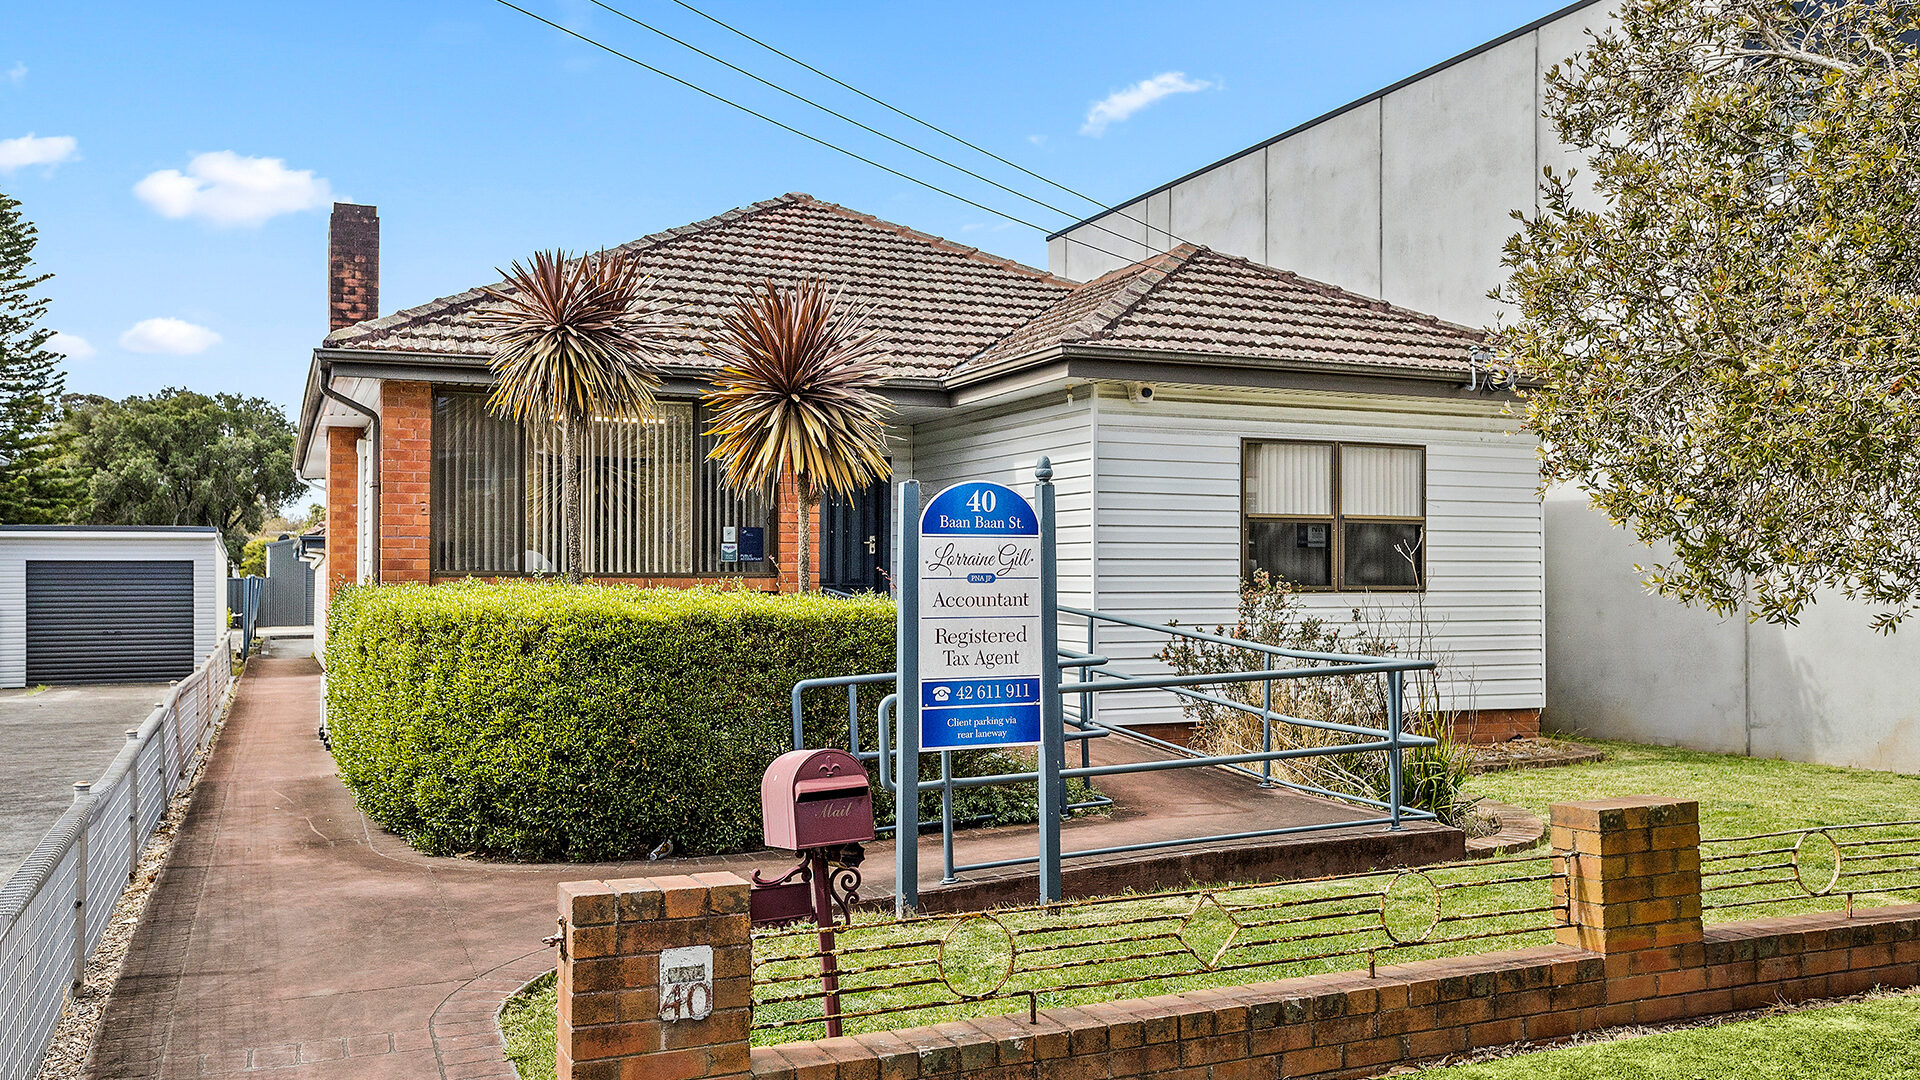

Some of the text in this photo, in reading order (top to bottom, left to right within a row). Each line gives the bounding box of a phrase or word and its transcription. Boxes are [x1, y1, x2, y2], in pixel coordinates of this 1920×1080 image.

[966, 489, 997, 513] 40
[939, 514, 1025, 529] Baan Baan St.
[928, 542, 1032, 577] Lorraine Gill
[971, 574, 993, 583] PNA JP
[932, 591, 1030, 608] Accountant
[934, 624, 1028, 649] Registered
[942, 649, 1020, 670] Tax Agent
[955, 683, 1031, 700] 42 611 911
[946, 715, 1018, 728] Client parking via
[957, 728, 1008, 739] rear laneway
[814, 801, 853, 818] Mail
[657, 982, 713, 1022] 40
